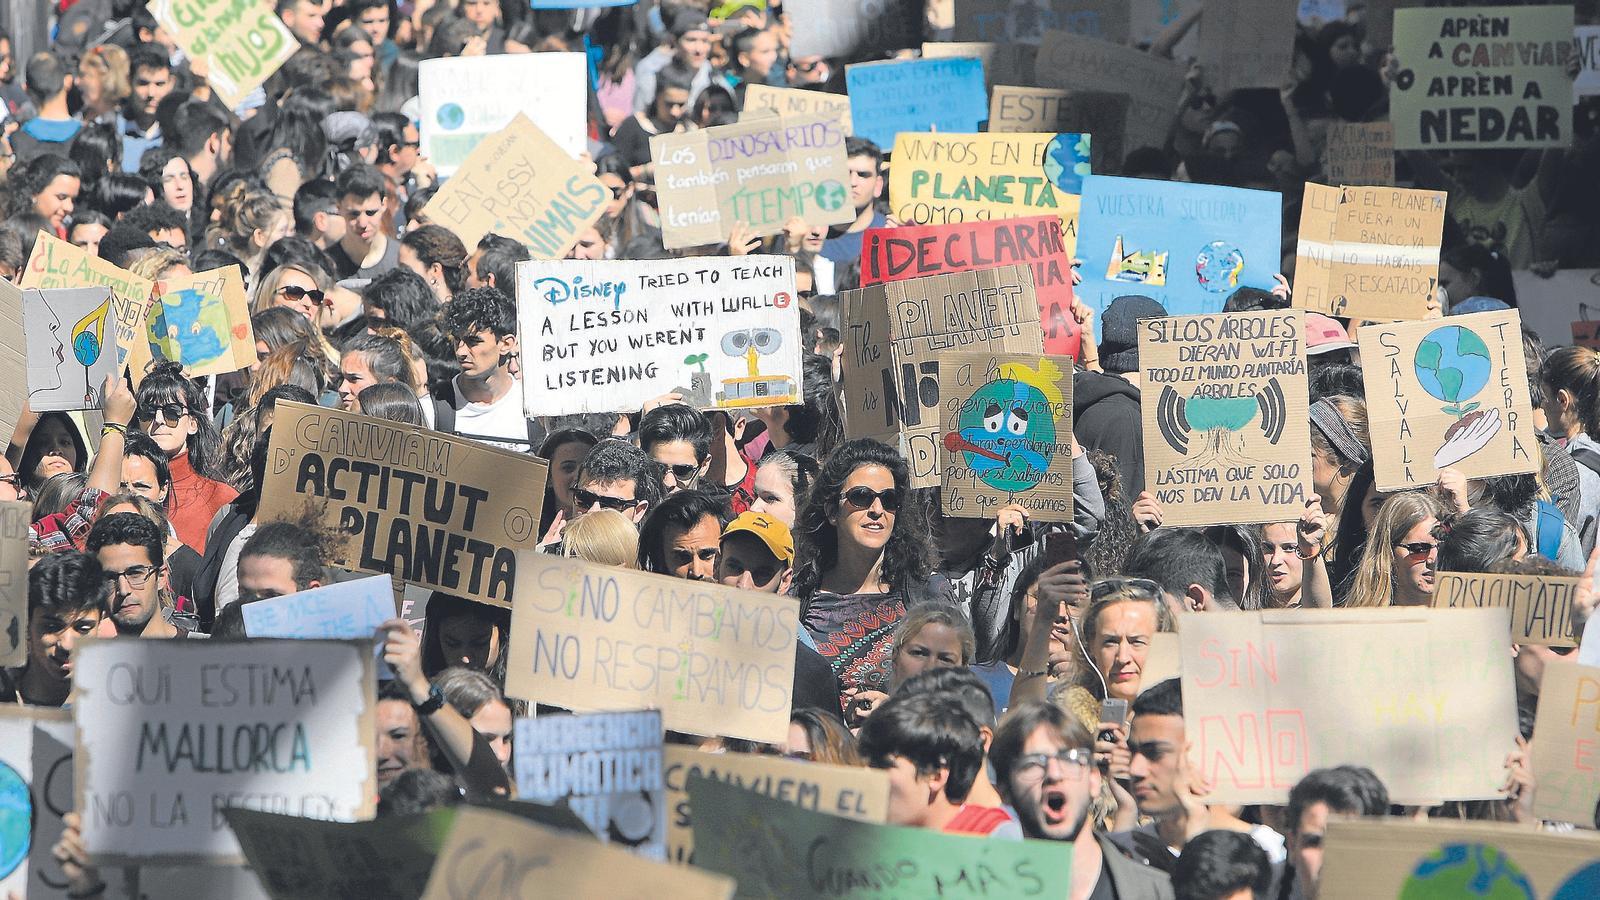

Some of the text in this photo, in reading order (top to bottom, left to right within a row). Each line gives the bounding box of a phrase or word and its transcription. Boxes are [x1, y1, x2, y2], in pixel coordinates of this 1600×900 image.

[1440, 13, 1510, 38] APRÈN
[1428, 41, 1444, 59] A
[1396, 68, 1542, 100] O APRÈN A
[1420, 104, 1561, 144] NEDAR
[707, 117, 842, 165] DINOSAURIOS
[990, 140, 1020, 166] EN
[439, 171, 484, 225] EAT
[480, 155, 537, 217] PUSSY
[911, 169, 1059, 208] PLANETA
[506, 189, 543, 231] NOT
[524, 175, 606, 258] NIMALS
[899, 202, 963, 226] COMO
[1096, 193, 1166, 218] VUESTRA
[1364, 191, 1382, 208] EL
[1391, 191, 1444, 214] PLANETA
[1347, 209, 1421, 230] FUERA UN
[1411, 235, 1425, 249] YA
[1342, 252, 1359, 266] LO
[638, 270, 690, 291] TRIED
[694, 268, 721, 286] TO
[730, 264, 783, 282] TEACH
[541, 315, 554, 337] A
[568, 308, 649, 333] LESSON
[670, 300, 715, 319] WITH
[896, 285, 1024, 356] PLANET
[1148, 314, 1297, 344] SI LOS ÁRBOLES
[542, 341, 579, 363] BUT
[589, 338, 619, 358] YOU
[850, 320, 881, 369] The
[1179, 339, 1300, 363] DIERAN WI-FI
[545, 361, 660, 391] LISTENING
[956, 356, 1019, 387] a las
[1147, 357, 1306, 384] TODO EL MUNDO PLANTARÍA
[862, 387, 879, 412] is
[1190, 382, 1258, 401] ÁRBOLES
[1490, 321, 1531, 463] TIERRA
[295, 413, 452, 477] CANVIAM
[945, 465, 990, 491] porque
[1156, 462, 1300, 486] LÁSTIMA QUE SOLO
[947, 487, 964, 512] lo
[975, 494, 998, 518] que
[1155, 482, 1305, 505] NOS DEN LA VIDA
[503, 506, 534, 543] O
[340, 505, 518, 604] PLANETA
[579, 574, 621, 623] NO
[532, 629, 580, 681] NO
[1195, 636, 1280, 689] SIN
[1373, 690, 1449, 727] HAY
[135, 721, 312, 775] MALLORCA
[1198, 708, 1311, 789] NO
[91, 790, 136, 828] NO
[150, 794, 189, 829] LA
[837, 788, 868, 814] EL
